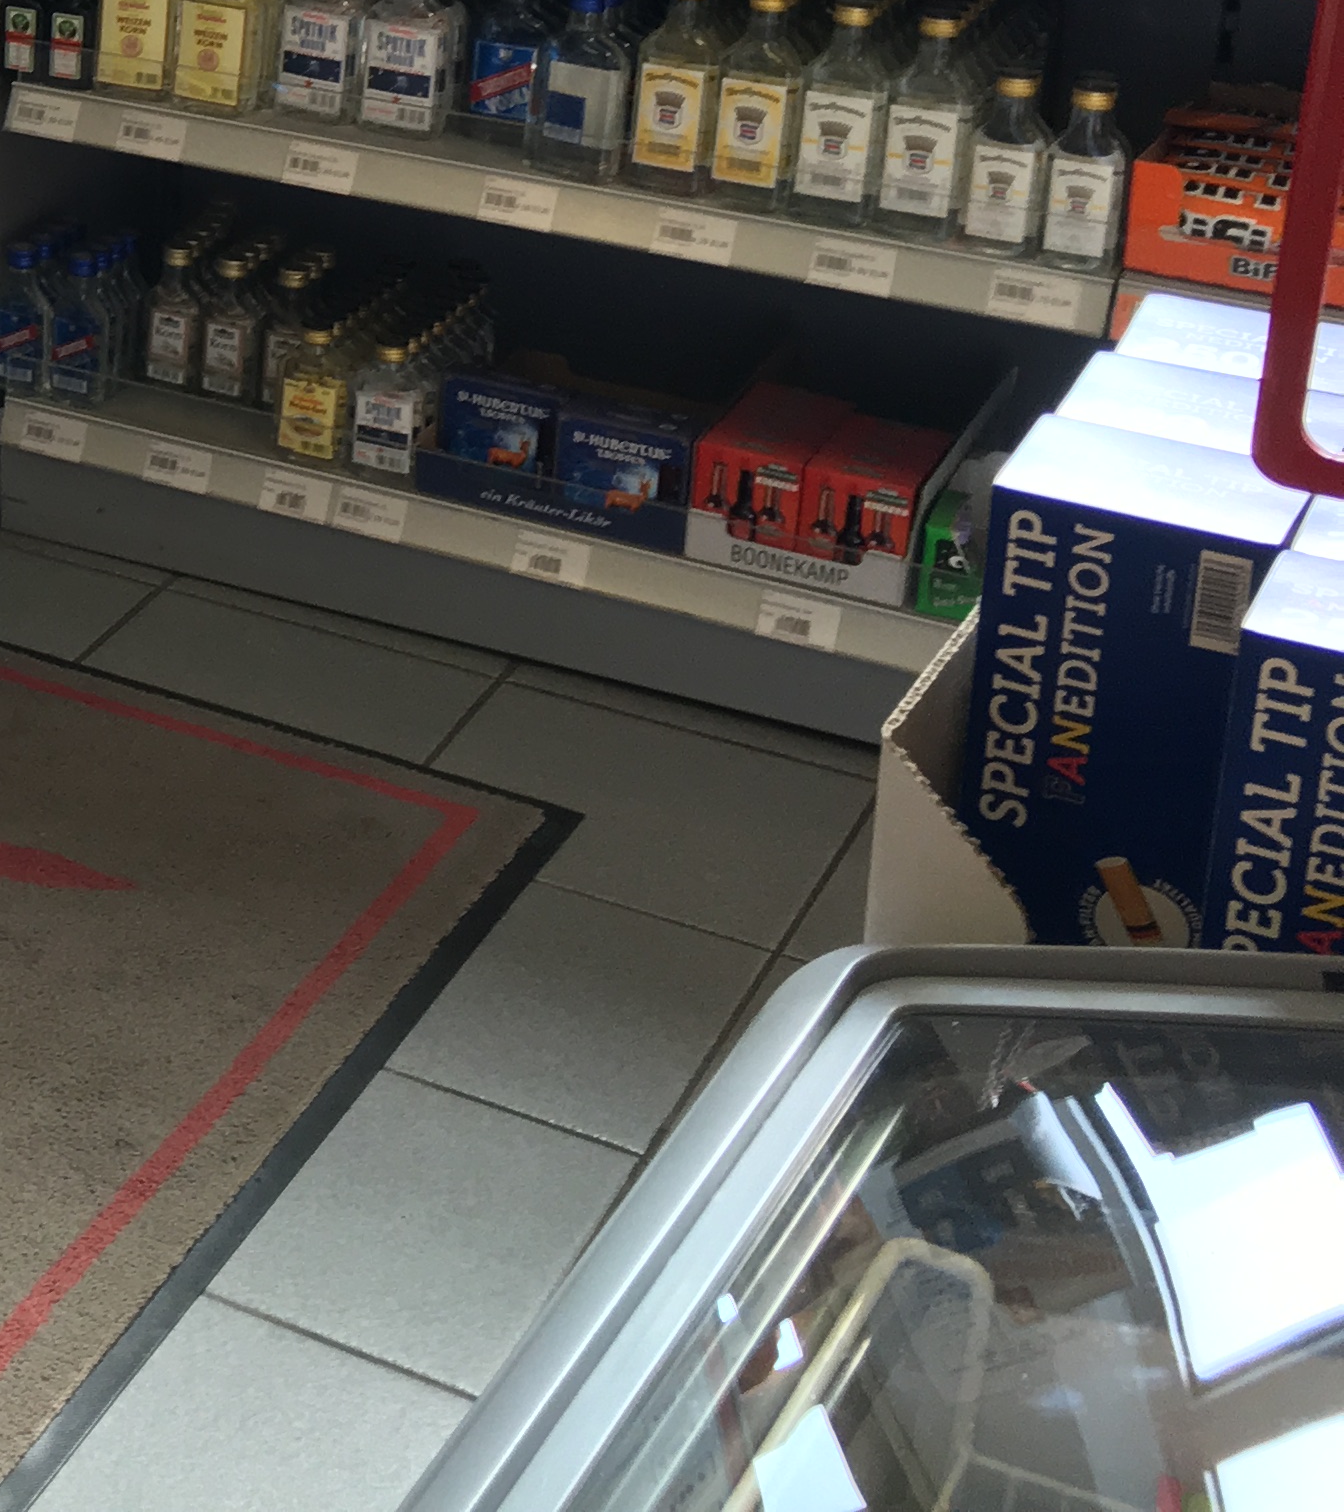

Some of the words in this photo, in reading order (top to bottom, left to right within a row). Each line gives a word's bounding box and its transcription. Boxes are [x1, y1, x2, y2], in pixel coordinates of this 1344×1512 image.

[507, 491, 614, 529] Kräuter-Likör
[1002, 509, 1059, 592] TIP
[729, 544, 849, 586] BOONEKAMP
[1043, 523, 1116, 804] FANEDITION
[979, 614, 1049, 829] SPECIAL
